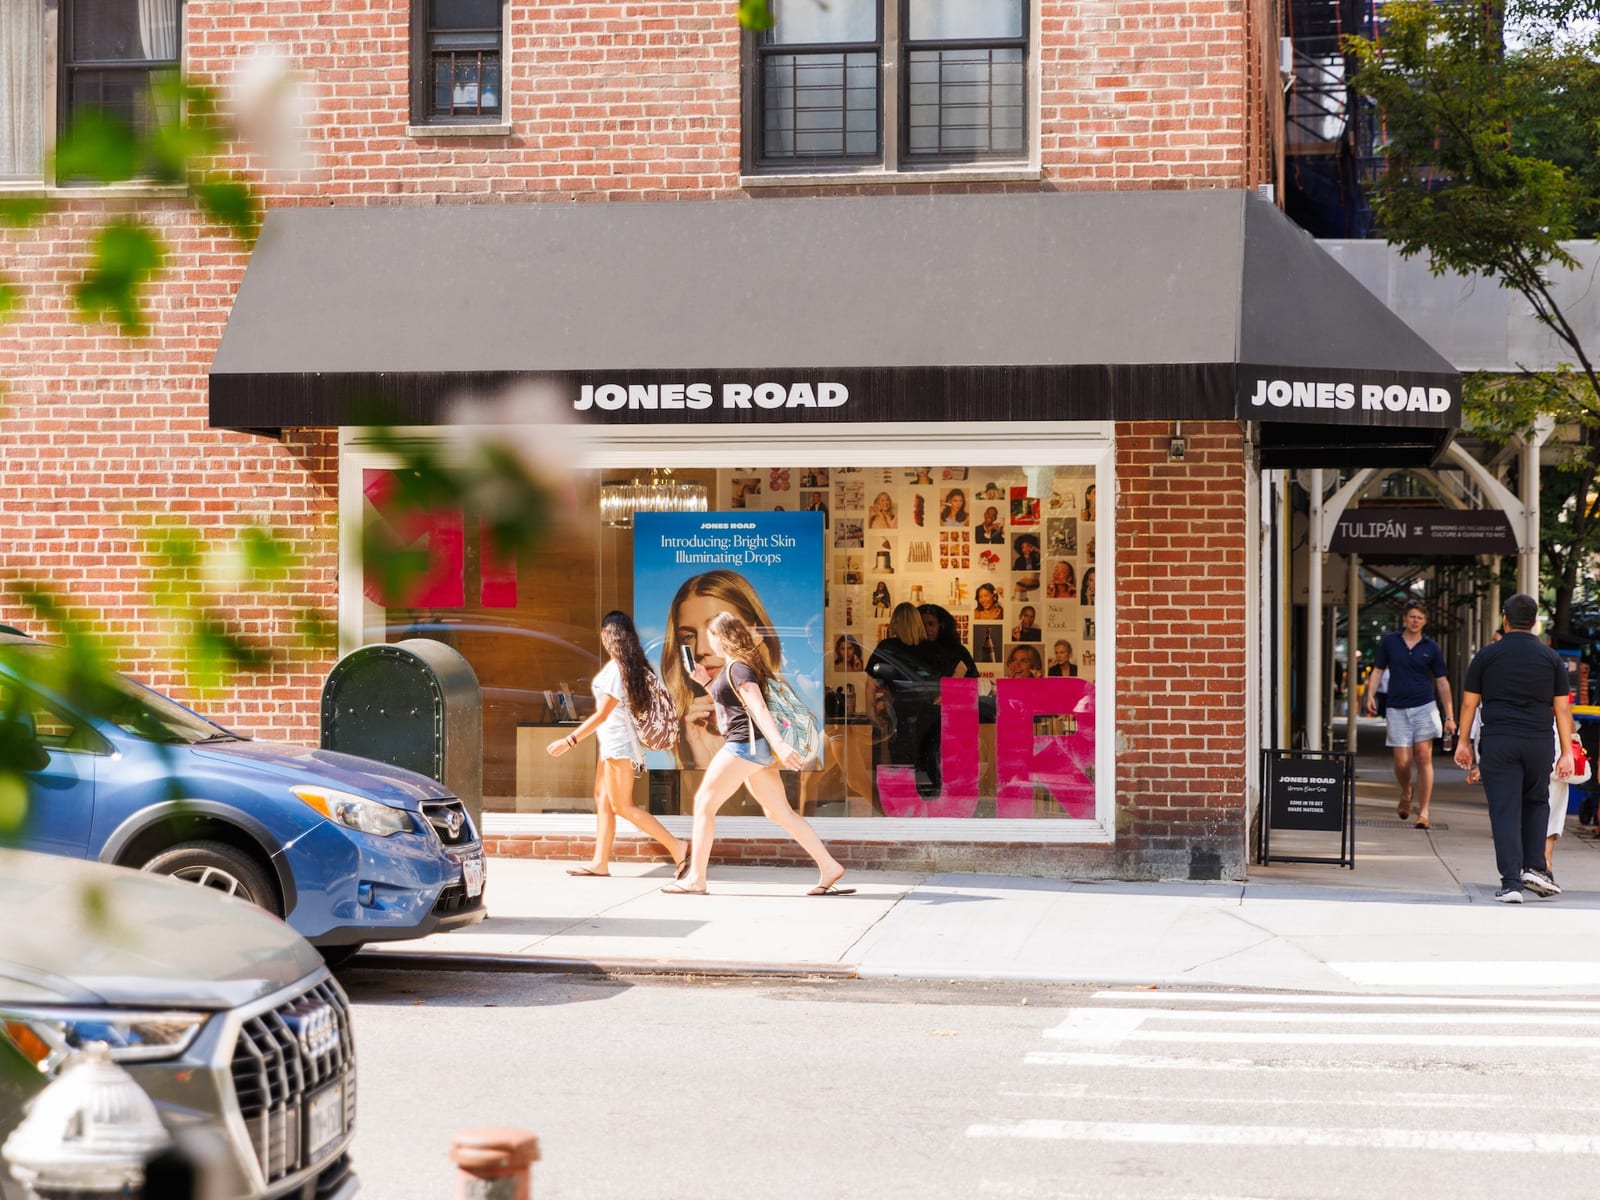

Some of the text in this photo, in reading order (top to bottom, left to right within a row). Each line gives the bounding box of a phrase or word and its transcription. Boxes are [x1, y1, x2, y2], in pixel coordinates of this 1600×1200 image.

[573, 382, 849, 411] JONES ROAD
[1251, 380, 1452, 413] JONES ROAD
[700, 522, 757, 530] JONES ROAD
[1339, 519, 1407, 538] TULIPÁN
[660, 534, 796, 551] Introducing: Bright Skin
[675, 550, 782, 566] Illuminating Drops
[876, 677, 1096, 818] JR
